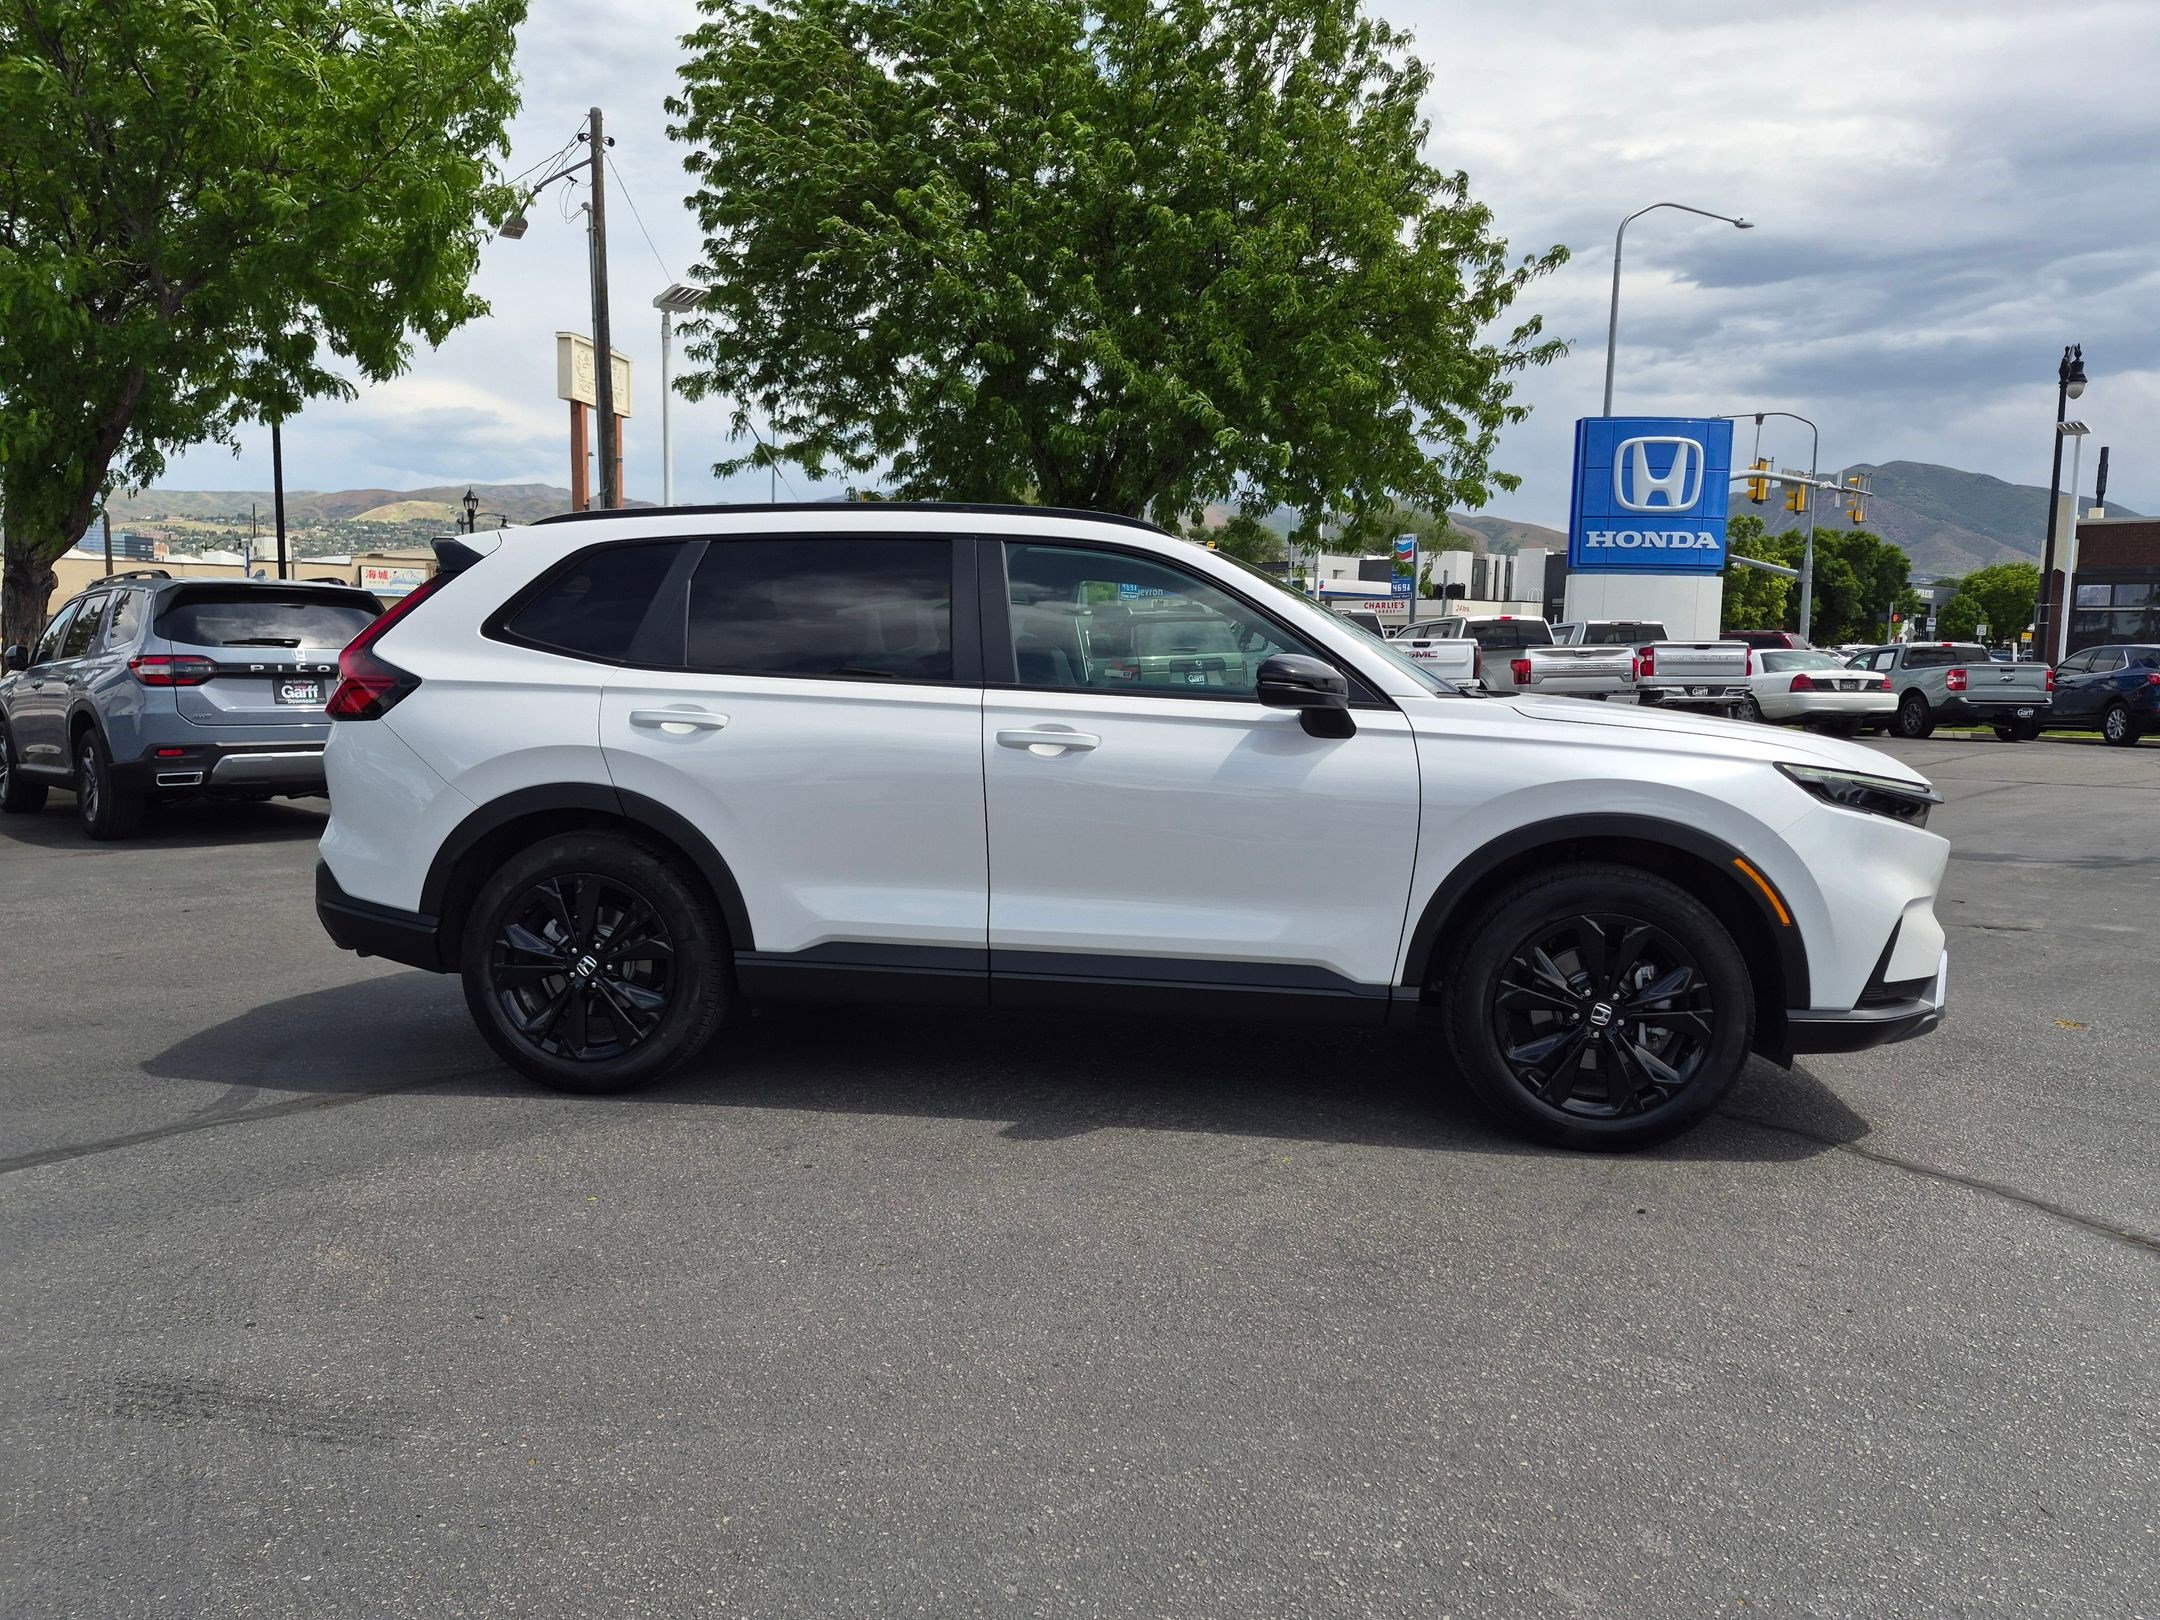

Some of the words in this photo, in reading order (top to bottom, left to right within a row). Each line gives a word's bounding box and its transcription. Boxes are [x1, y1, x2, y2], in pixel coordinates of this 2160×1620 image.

[1586, 531, 1720, 549] HONDA
[1363, 601, 1405, 609] CHARLIE'S
[250, 664, 331, 673] PILO
[281, 685, 319, 699] Garff
